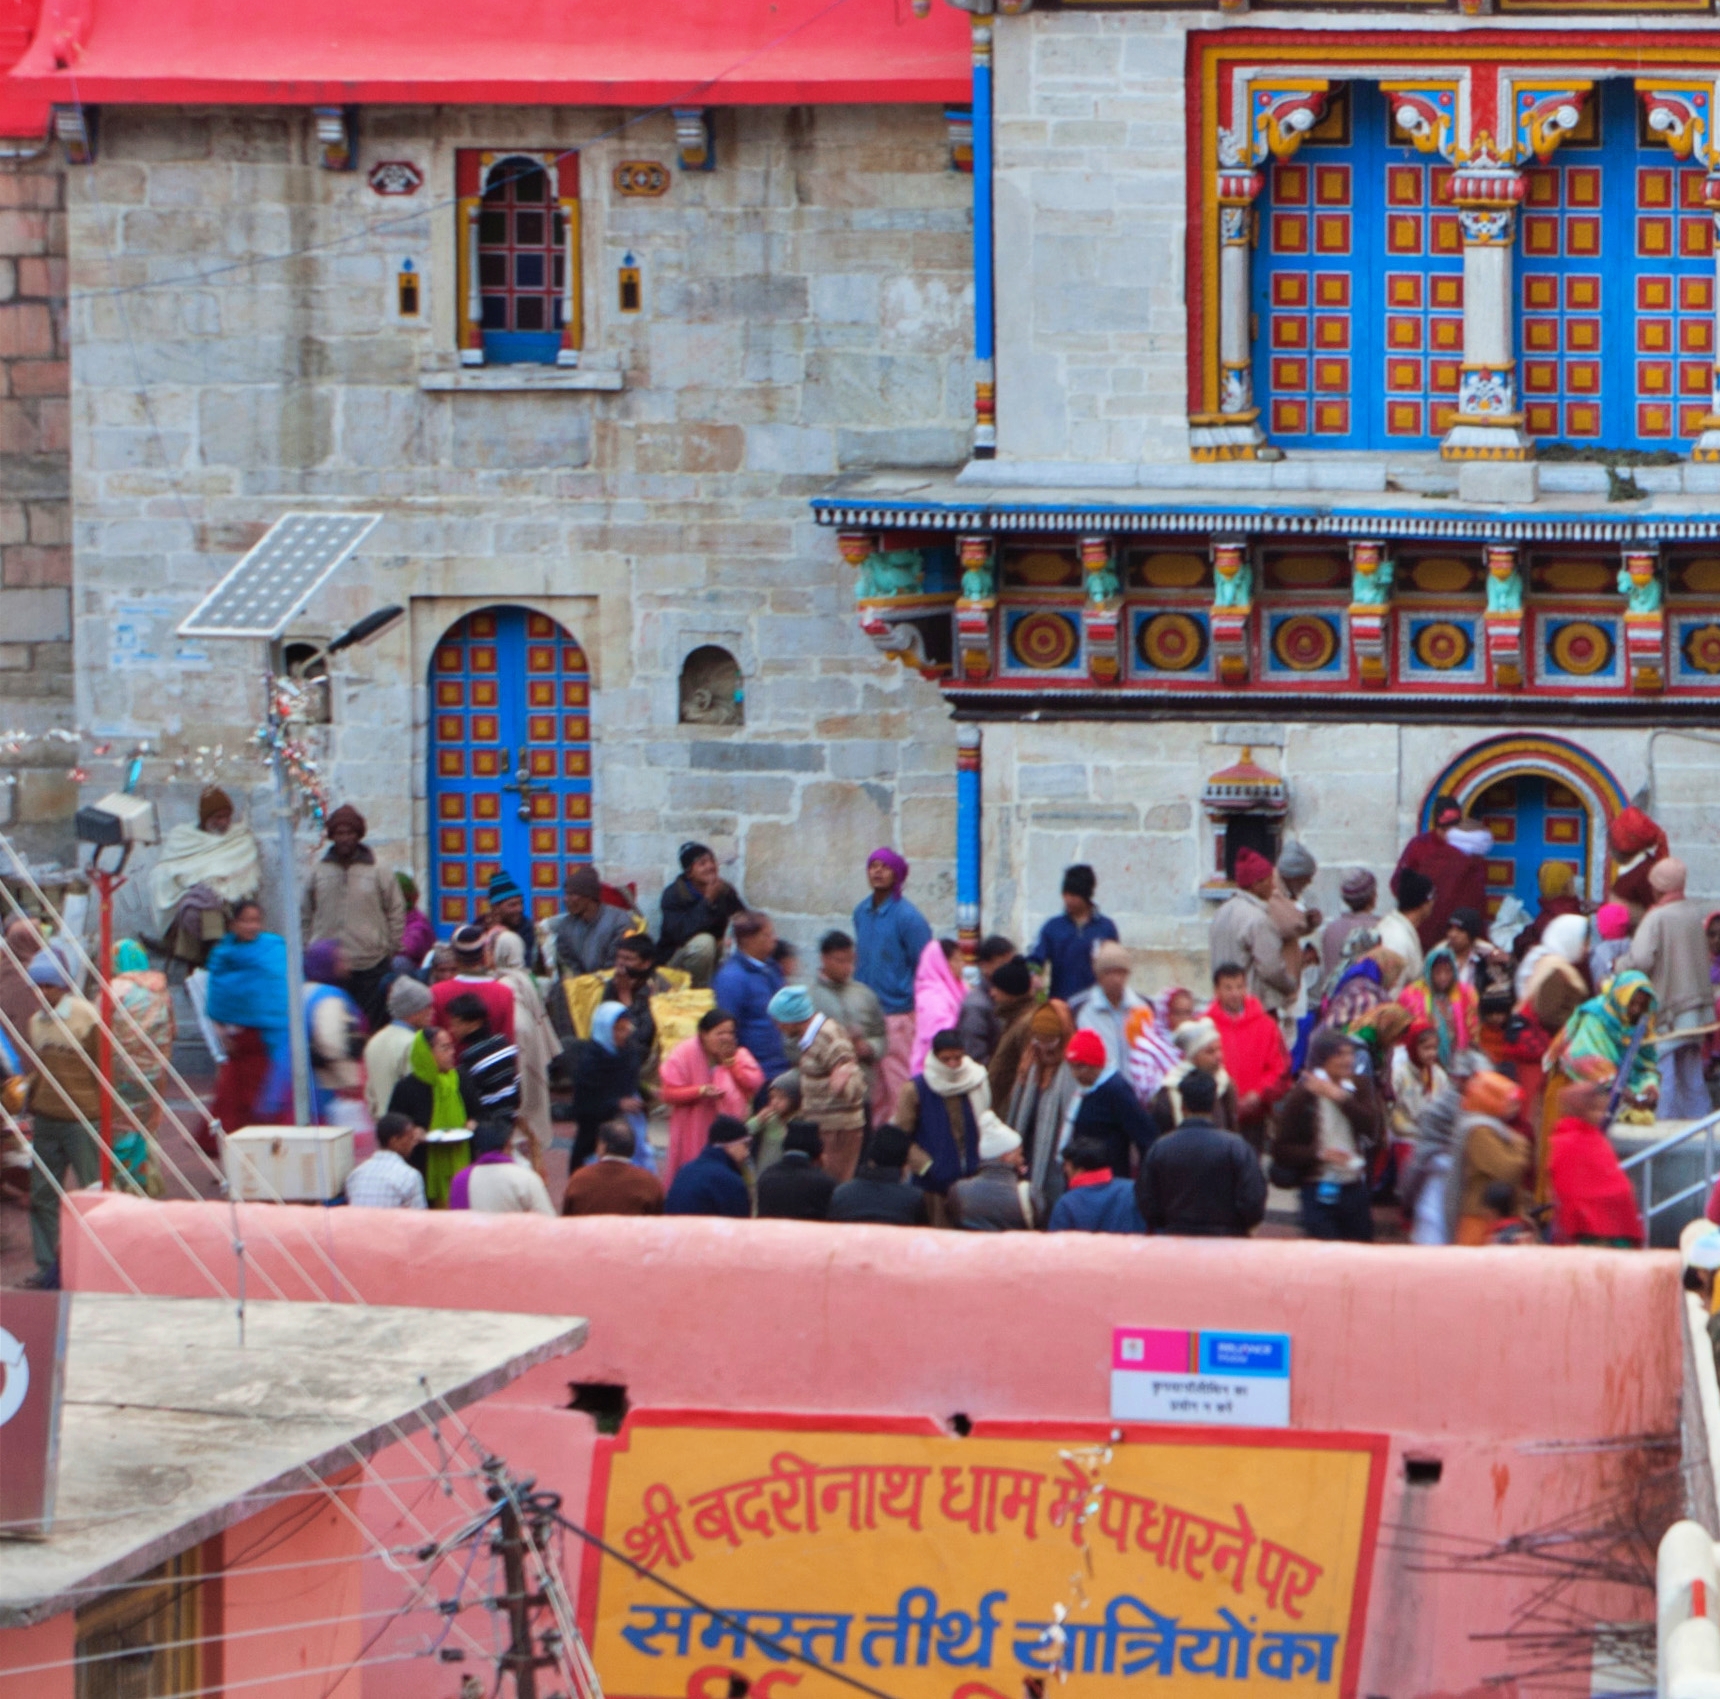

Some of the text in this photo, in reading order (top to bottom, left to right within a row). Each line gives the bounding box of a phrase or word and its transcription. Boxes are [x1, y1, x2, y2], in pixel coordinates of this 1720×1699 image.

[624, 1482, 693, 1580] श्री
[687, 1451, 931, 1547] बदरीनाथ
[940, 1465, 1046, 1541] धाम
[1098, 1486, 1257, 1595] पधारने
[1256, 1539, 1325, 1621] पर
[620, 1604, 855, 1663] समस्त
[860, 1585, 1008, 1669] तीर्थ
[1256, 1631, 1340, 1684] का
